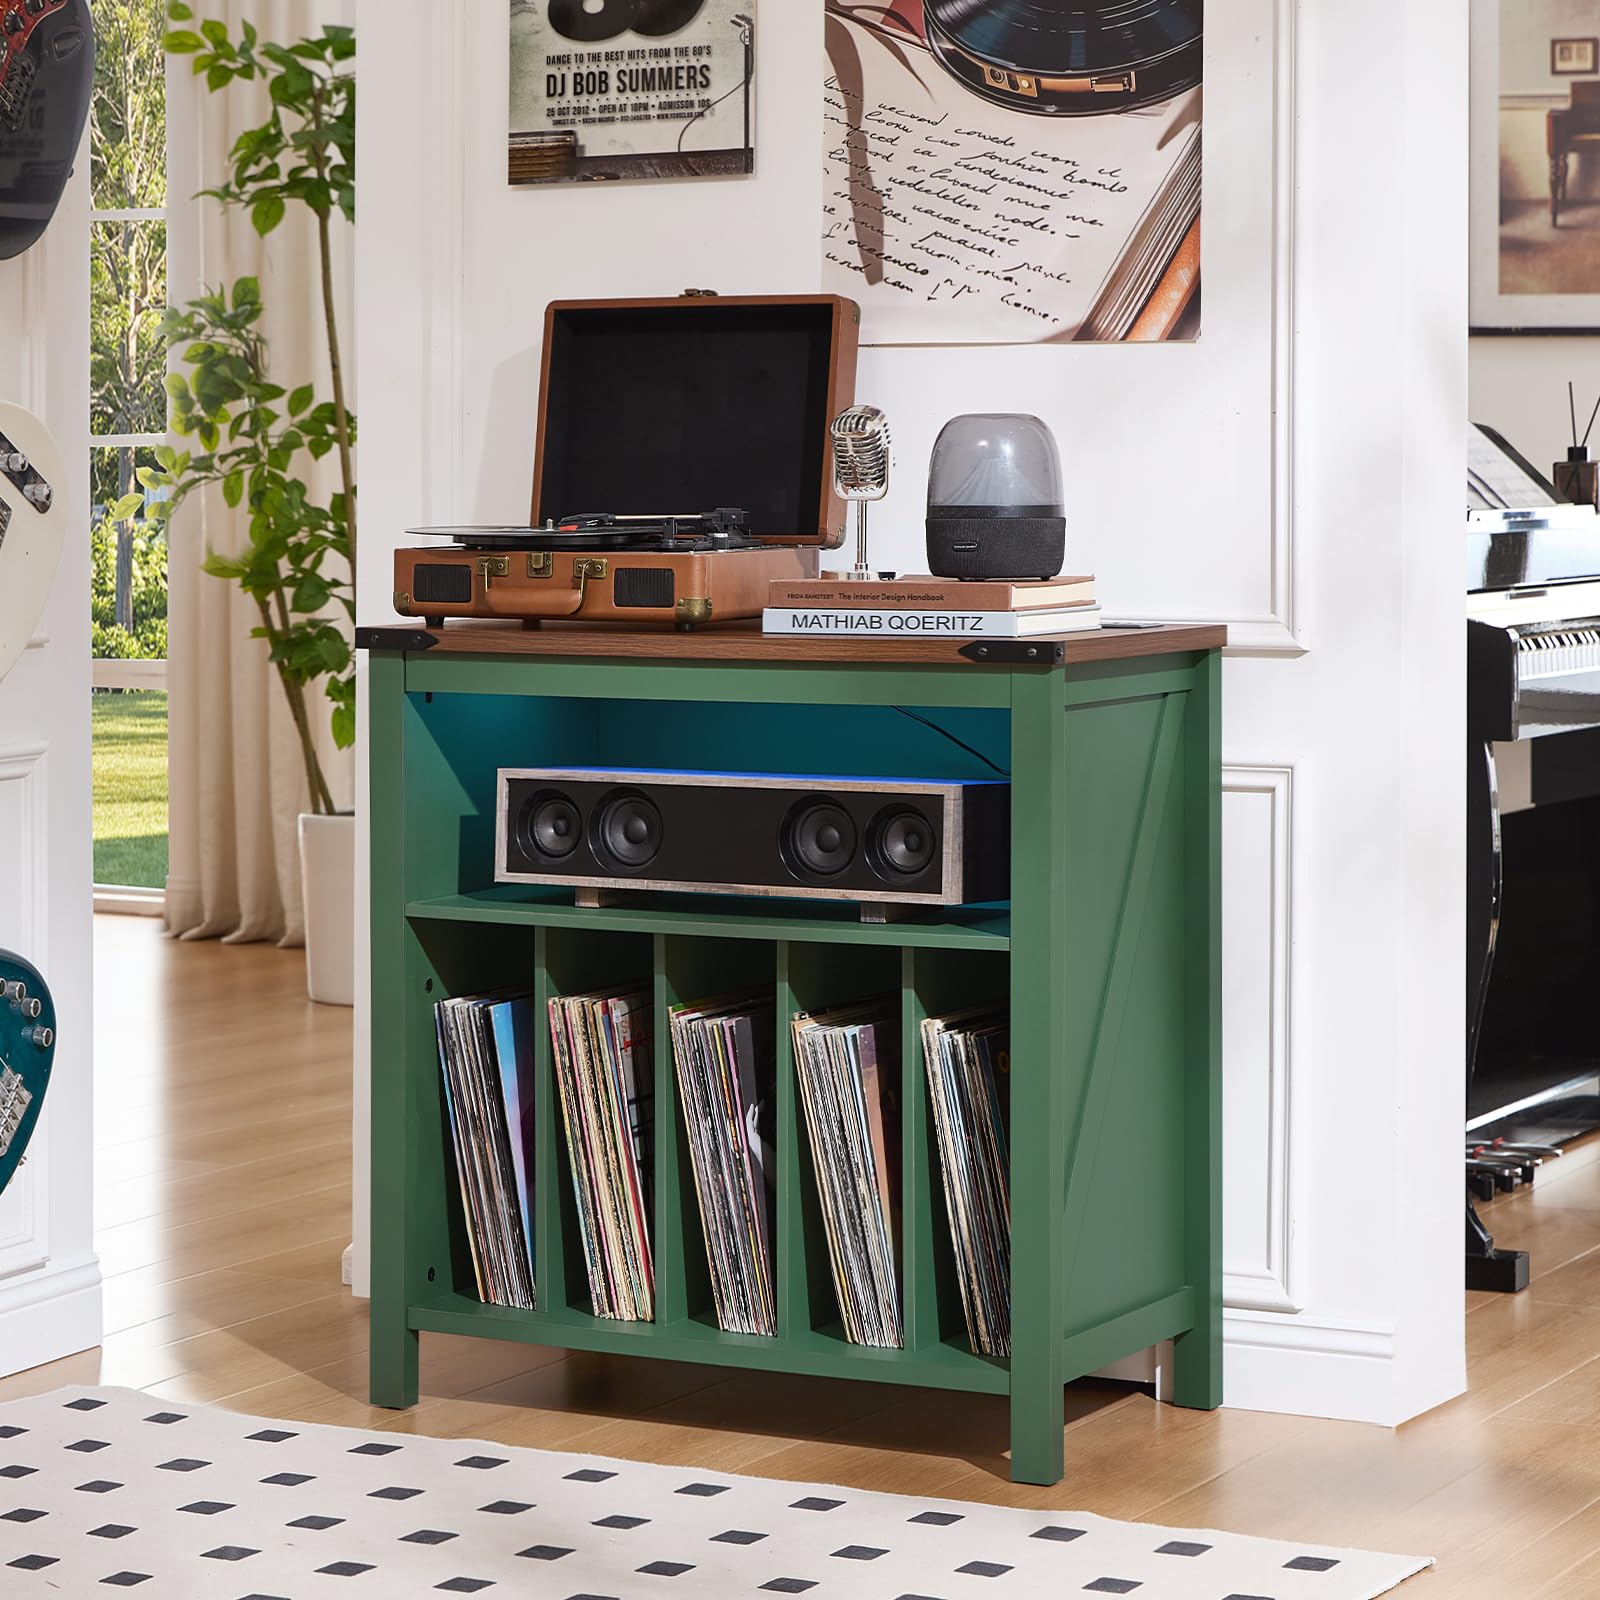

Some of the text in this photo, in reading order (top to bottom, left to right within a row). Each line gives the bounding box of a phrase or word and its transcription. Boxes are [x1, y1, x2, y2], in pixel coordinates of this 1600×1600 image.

[546, 45, 712, 66] DANCE TO THE BEST HITS FROM THE 80'S
[546, 64, 711, 98] DJ BOB SUMMERS
[546, 107, 556, 117] 25
[557, 106, 571, 116] OCT
[572, 105, 590, 115] 2012
[598, 104, 617, 114] OPEN
[618, 103, 627, 112] AT
[630, 102, 649, 112] 10PM
[838, 592, 945, 603] The Interior Design Handbook
[791, 614, 984, 631] MATHIAB QOERITZ
